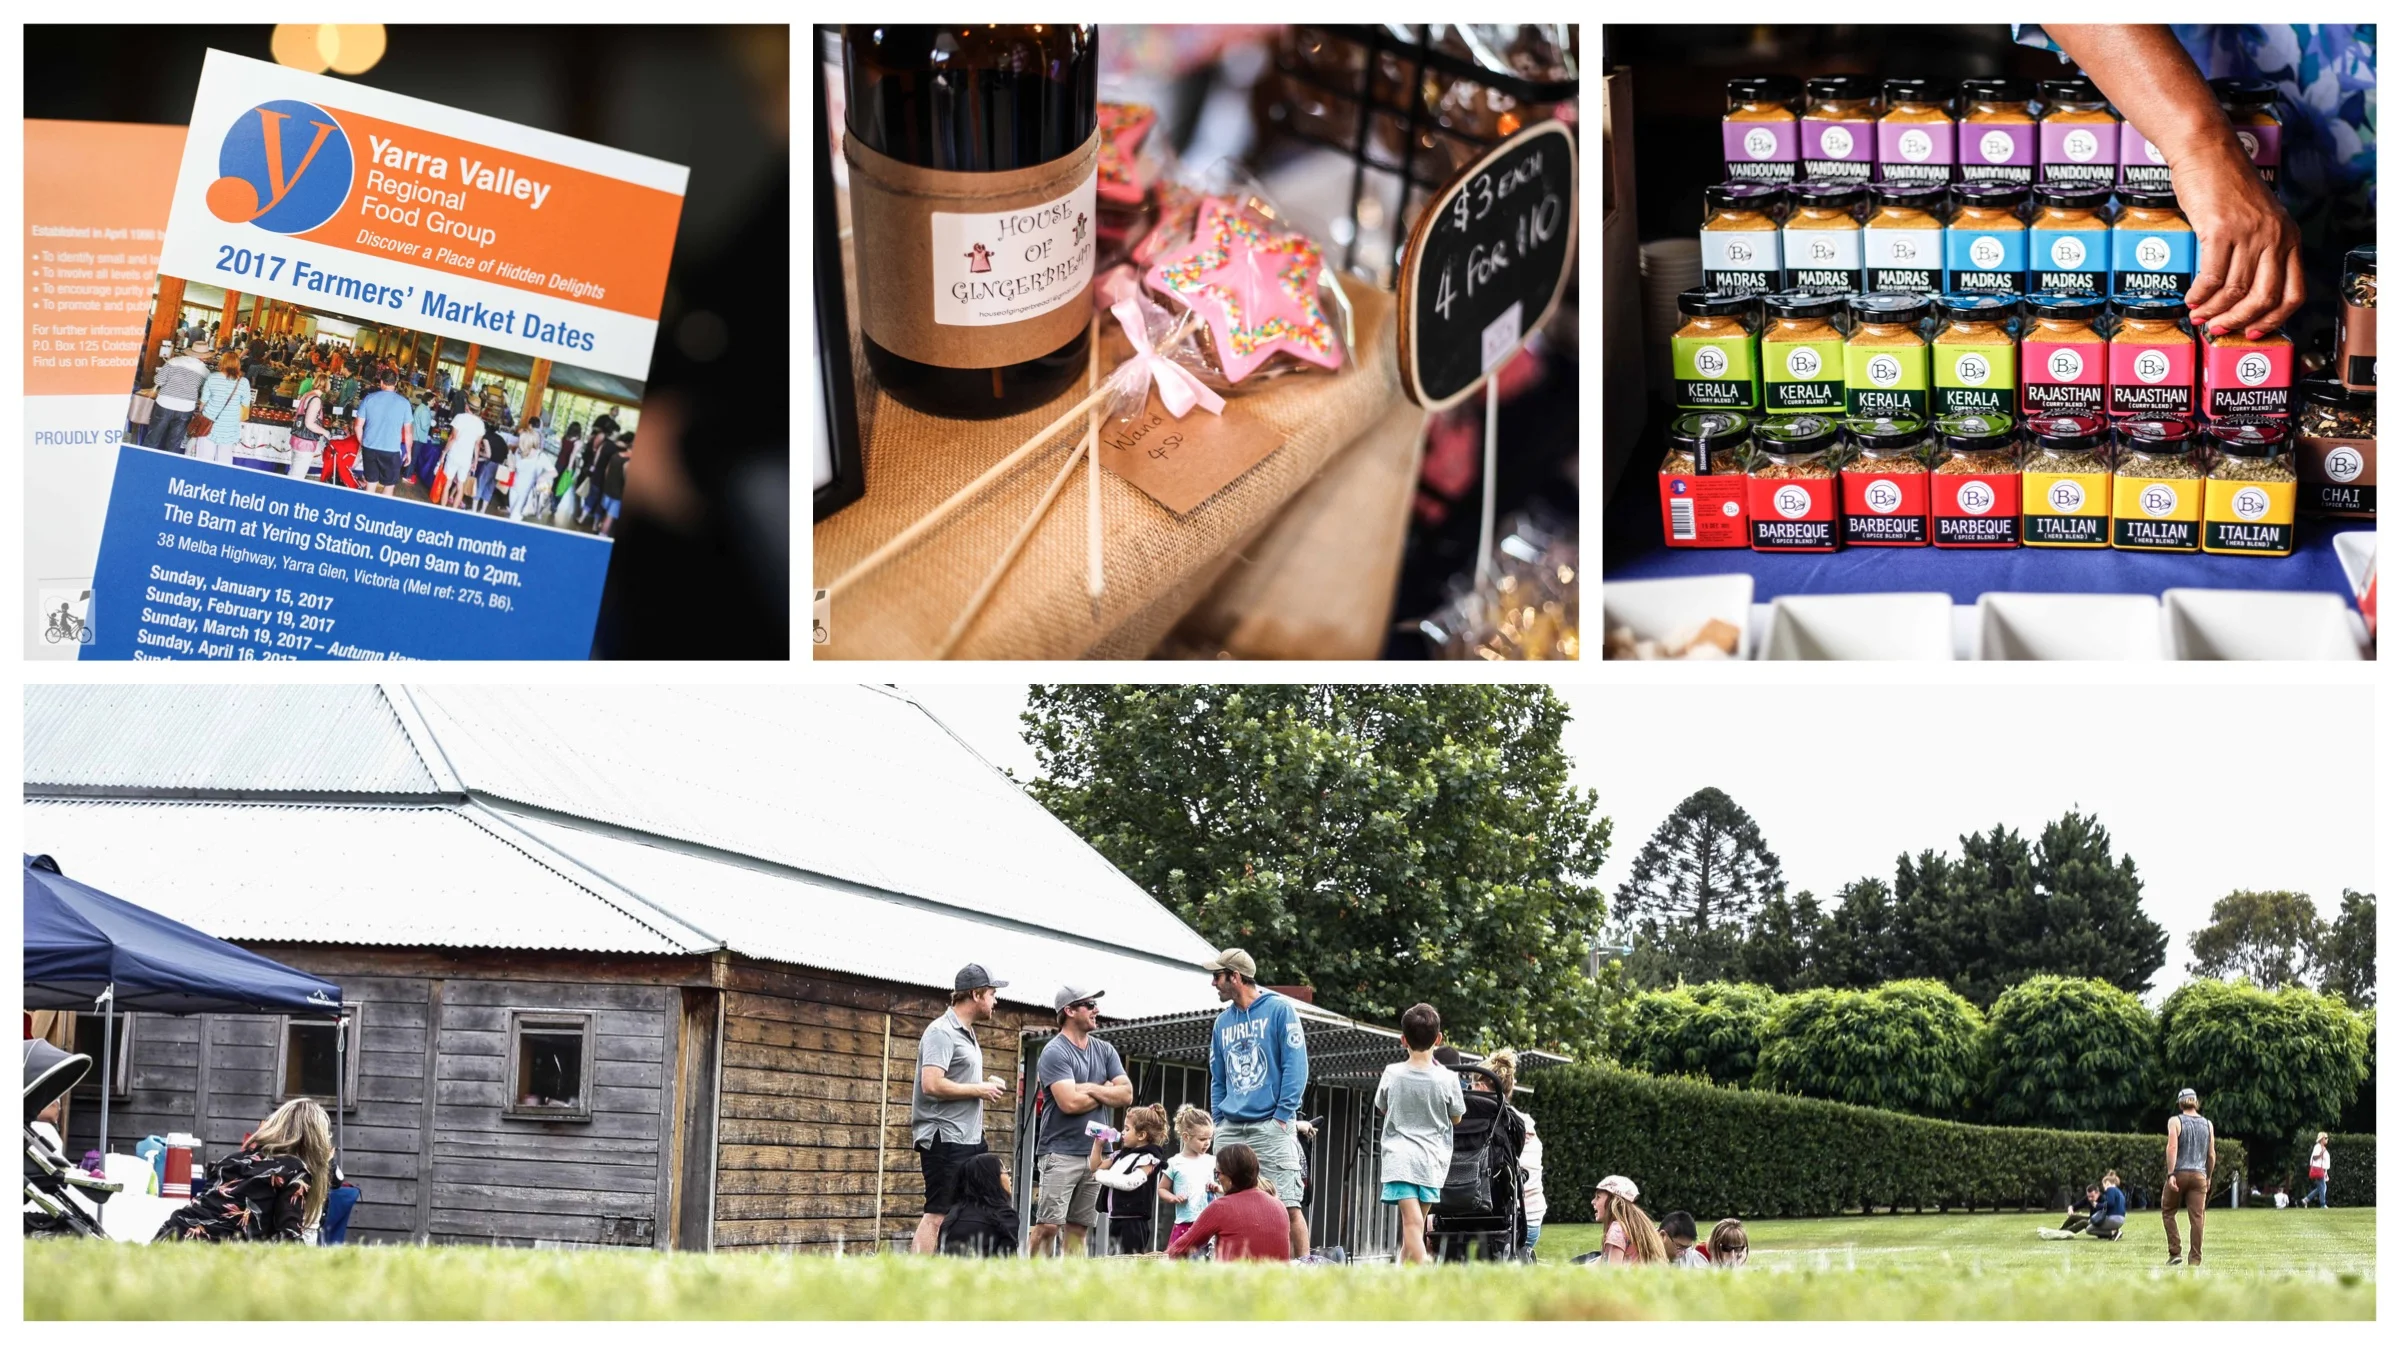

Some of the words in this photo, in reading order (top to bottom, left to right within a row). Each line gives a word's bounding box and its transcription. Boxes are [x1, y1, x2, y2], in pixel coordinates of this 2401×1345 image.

[368, 134, 448, 181] Yarra
[460, 157, 552, 210] Valley
[1729, 163, 1795, 177] VANDOUVAN
[1804, 161, 1870, 177] VANDOUVAN
[1882, 164, 1950, 179] VANDOUVAN
[1962, 166, 2031, 181] VANDOUVAN
[2044, 165, 2114, 180] VANDOUVAN
[366, 169, 467, 211] Regional
[1453, 173, 1494, 233] $3
[1497, 150, 1544, 200] EACH
[360, 195, 421, 228] Food
[426, 211, 497, 249] Group
[998, 200, 1073, 242] HOUSE
[42, 250, 54, 262] To
[1025, 239, 1054, 263] OF
[42, 266, 54, 278] To
[355, 228, 421, 256] Discover
[421, 247, 433, 260] a
[435, 247, 476, 269] Place
[477, 259, 496, 273] of
[495, 261, 546, 286] Hidden
[547, 273, 606, 300] Delights
[952, 244, 1092, 304] GINGERBREAD
[1716, 272, 1766, 287] MADRAS
[1798, 271, 1849, 286] MADRAS
[1878, 270, 1930, 285] MADRAS
[1960, 273, 2012, 288] MADRAS
[2042, 273, 2093, 288] MADRAS
[2125, 274, 2178, 289] MADRAS
[42, 282, 54, 294] To
[1435, 258, 1458, 321] 4
[42, 298, 54, 310] To
[215, 244, 287, 282] 2017
[292, 260, 414, 310] Farmers'
[420, 290, 516, 335] Market
[522, 313, 595, 352] Dates
[32, 324, 49, 336] For
[52, 324, 87, 336] further
[55, 340, 76, 351] Box
[79, 340, 99, 352] 125
[33, 356, 56, 367] Find
[59, 357, 72, 367] us
[75, 357, 88, 367] on
[1688, 383, 1739, 398] KERALA
[1779, 384, 1832, 399] KERALA
[1947, 390, 2000, 406] KERALA
[2028, 386, 2101, 402] RAJASTHAN
[2115, 388, 2187, 403] RAJASTHAN
[2215, 390, 2288, 406] RAJASTHAN
[1859, 392, 1912, 408] KERALA
[35, 430, 100, 445] PROUDLY
[1104, 411, 1164, 451] Wand
[2322, 487, 2361, 503] CHAI
[167, 477, 227, 505] Market
[229, 489, 266, 512] held
[268, 500, 290, 517] on
[293, 502, 320, 523] the
[322, 508, 352, 529] 3rd
[354, 513, 414, 544] Sunday
[416, 529, 454, 549] each
[457, 537, 507, 559] month
[509, 545, 527, 562] at
[1849, 518, 1920, 534] BARBEQUE
[1941, 519, 2013, 535] BARBEQUE
[2037, 518, 2097, 534] ITALIAN
[1758, 523, 1829, 539] BARBEQUE
[2127, 522, 2188, 539] ITALIAN
[2218, 525, 2280, 542] ITALIAN
[164, 502, 194, 525] The
[197, 509, 237, 533] Barn
[239, 520, 258, 538] at
[262, 521, 311, 551] Yering
[314, 532, 374, 560] Station.
[379, 544, 421, 568] Open
[424, 553, 460, 576] 9am
[464, 560, 480, 579] to
[482, 564, 522, 587] 2pm.
[156, 532, 175, 548] 38
[177, 535, 218, 557] Melba
[220, 543, 277, 570] Highway,
[282, 555, 315, 575] Yarra
[318, 562, 349, 583] Glen,
[354, 568, 400, 590] Victoria
[402, 578, 432, 596] (Mel
[433, 585, 455, 600] ref:
[457, 588, 485, 608] 275,
[488, 593, 514, 613] B6).
[149, 564, 207, 591] Sunday,
[211, 576, 271, 603] January
[275, 587, 294, 607] 15,
[297, 592, 334, 611] 2017
[145, 585, 203, 613] Sunday,
[207, 597, 273, 625] February
[276, 610, 296, 629] 19,
[299, 614, 336, 633] 2017
[141, 607, 198, 634] Sunday,
[202, 618, 249, 640] March
[254, 627, 273, 647] 19,
[276, 632, 313, 651] 2017
[137, 628, 194, 655] Sunday,
[198, 639, 235, 659] April
[1221, 1018, 1269, 1050] HURLEY
